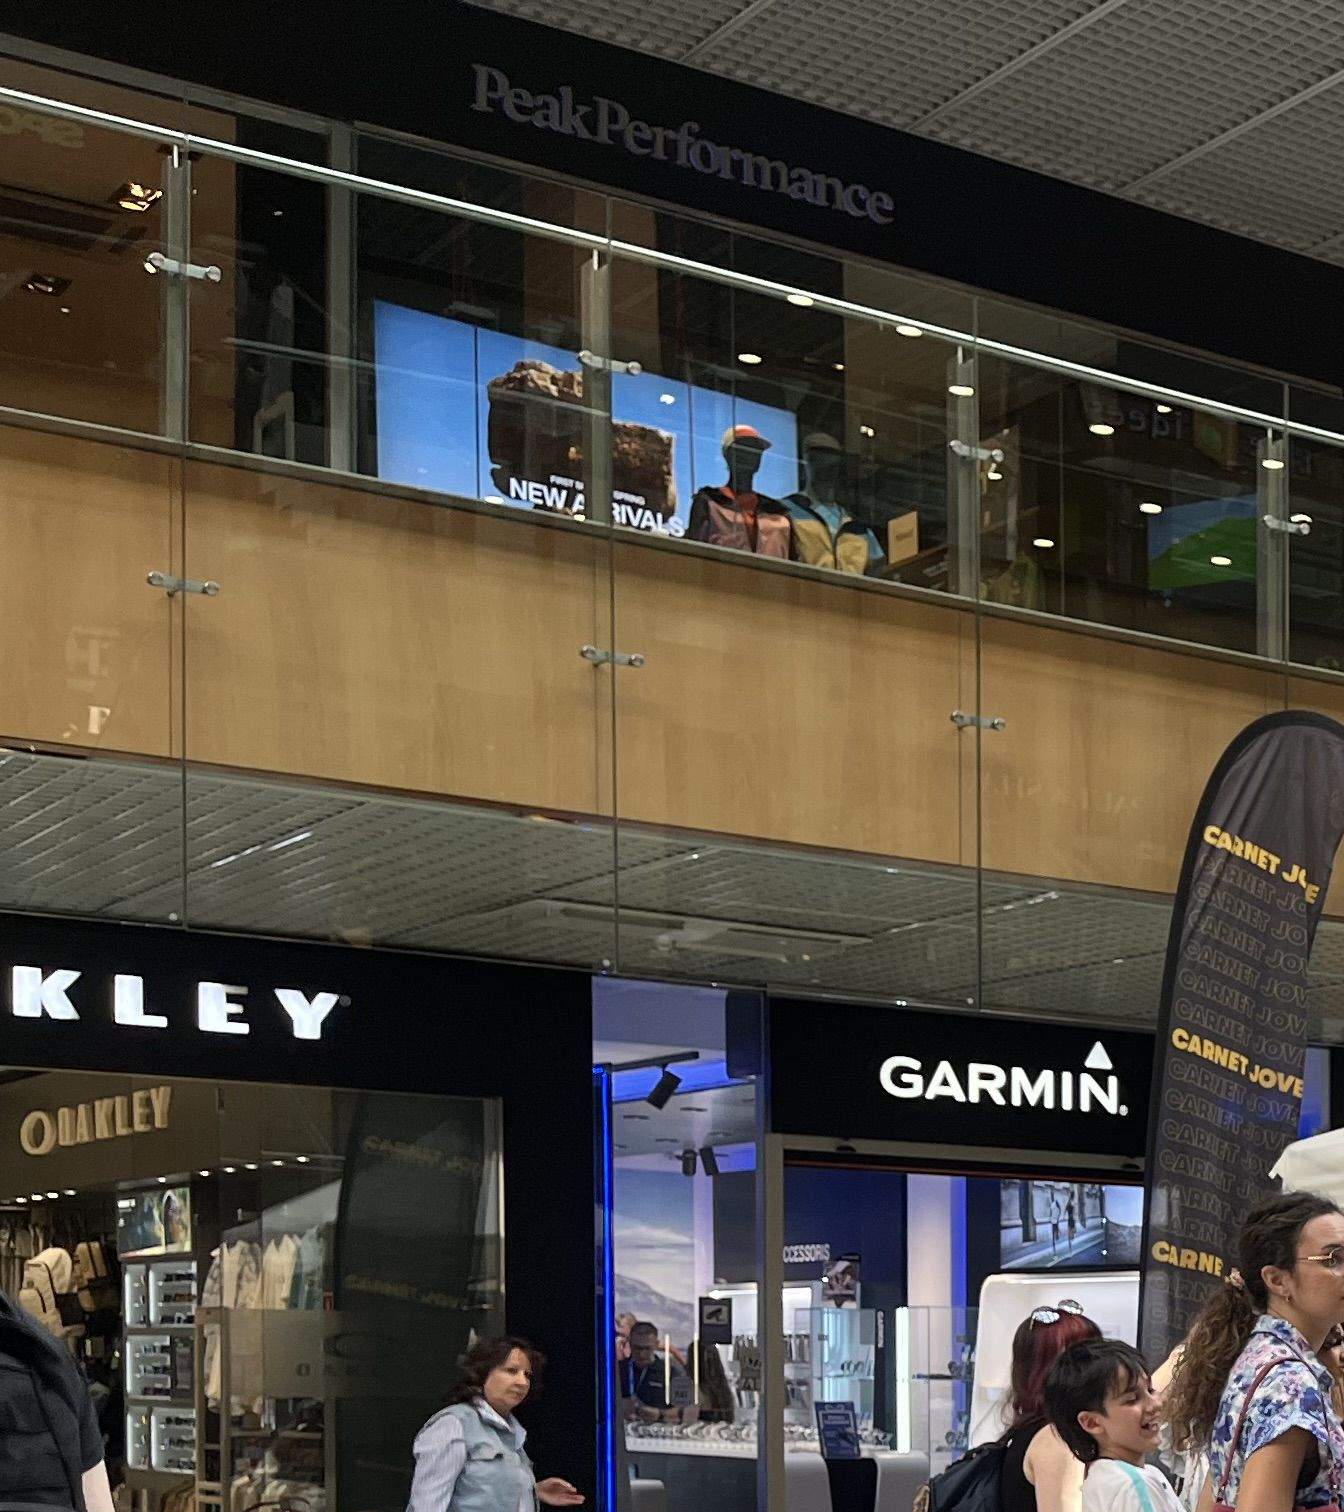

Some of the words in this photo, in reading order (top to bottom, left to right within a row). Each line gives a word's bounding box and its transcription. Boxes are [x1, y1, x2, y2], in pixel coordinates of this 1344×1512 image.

[509, 477, 568, 512] NEW
[572, 493, 686, 538] ARIVALS
[1203, 824, 1281, 875] CARNET
[1281, 863, 1321, 905] JE
[12, 965, 340, 1040] KLEY
[879, 1054, 1119, 1116] GARMIN
[1171, 1027, 1249, 1076] CARNET
[1249, 1063, 1305, 1098] JOVE
